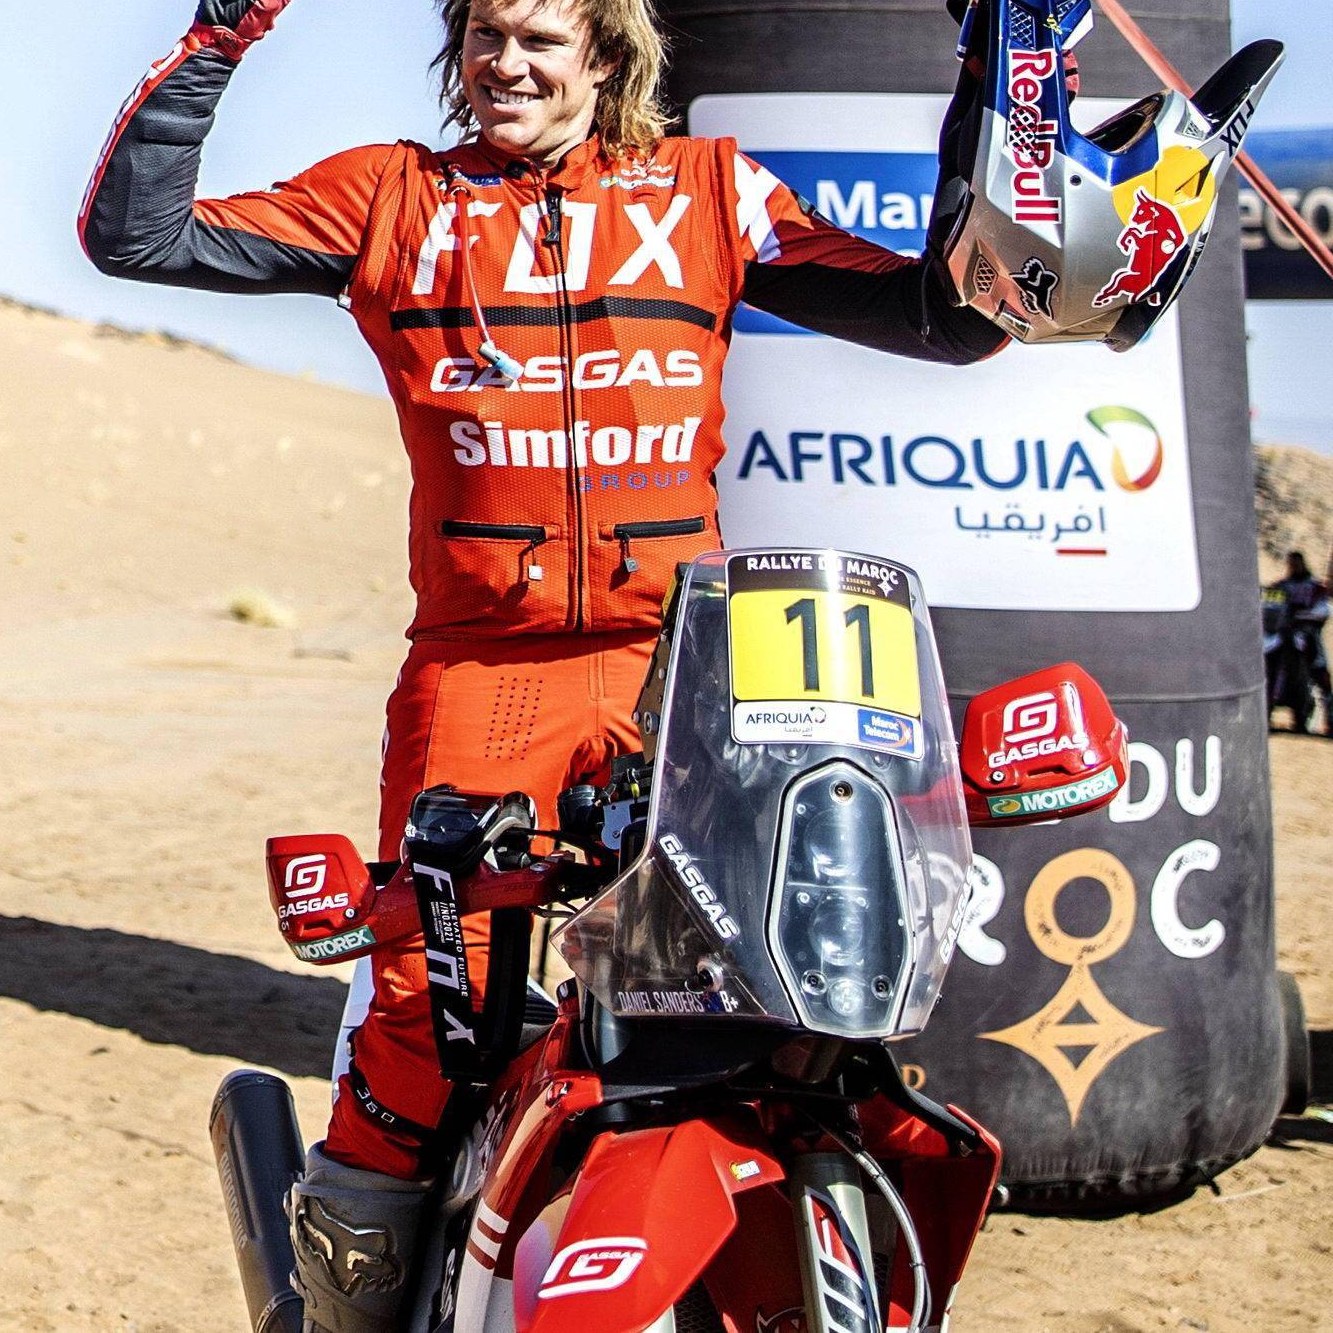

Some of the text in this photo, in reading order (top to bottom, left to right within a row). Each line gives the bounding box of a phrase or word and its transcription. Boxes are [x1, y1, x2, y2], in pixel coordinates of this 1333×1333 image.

[1011, 50, 1060, 223] Red Bull
[814, 180, 935, 230] Mar
[450, 416, 703, 468] Simford
[736, 428, 1106, 493] AFRIQUIA
[578, 469, 692, 492] GROUP
[746, 556, 812, 571] RALLYE
[847, 561, 899, 585] MAROC
[783, 596, 875, 700] 11
[745, 712, 813, 725] AFRIQUIA
[988, 734, 1090, 769] GASGAS
[1021, 772, 1114, 812] MOTOREX
[1107, 733, 1223, 825] DU
[278, 892, 349, 919] GASGAS
[658, 832, 741, 941] GASGAS
[295, 928, 372, 959] MOTOREX
[448, 902, 464, 953] ELEVATED
[457, 957, 470, 998] FUTURE
[617, 990, 739, 1013] DANIEL SANDERS B+
[356, 1087, 396, 1123] 360
